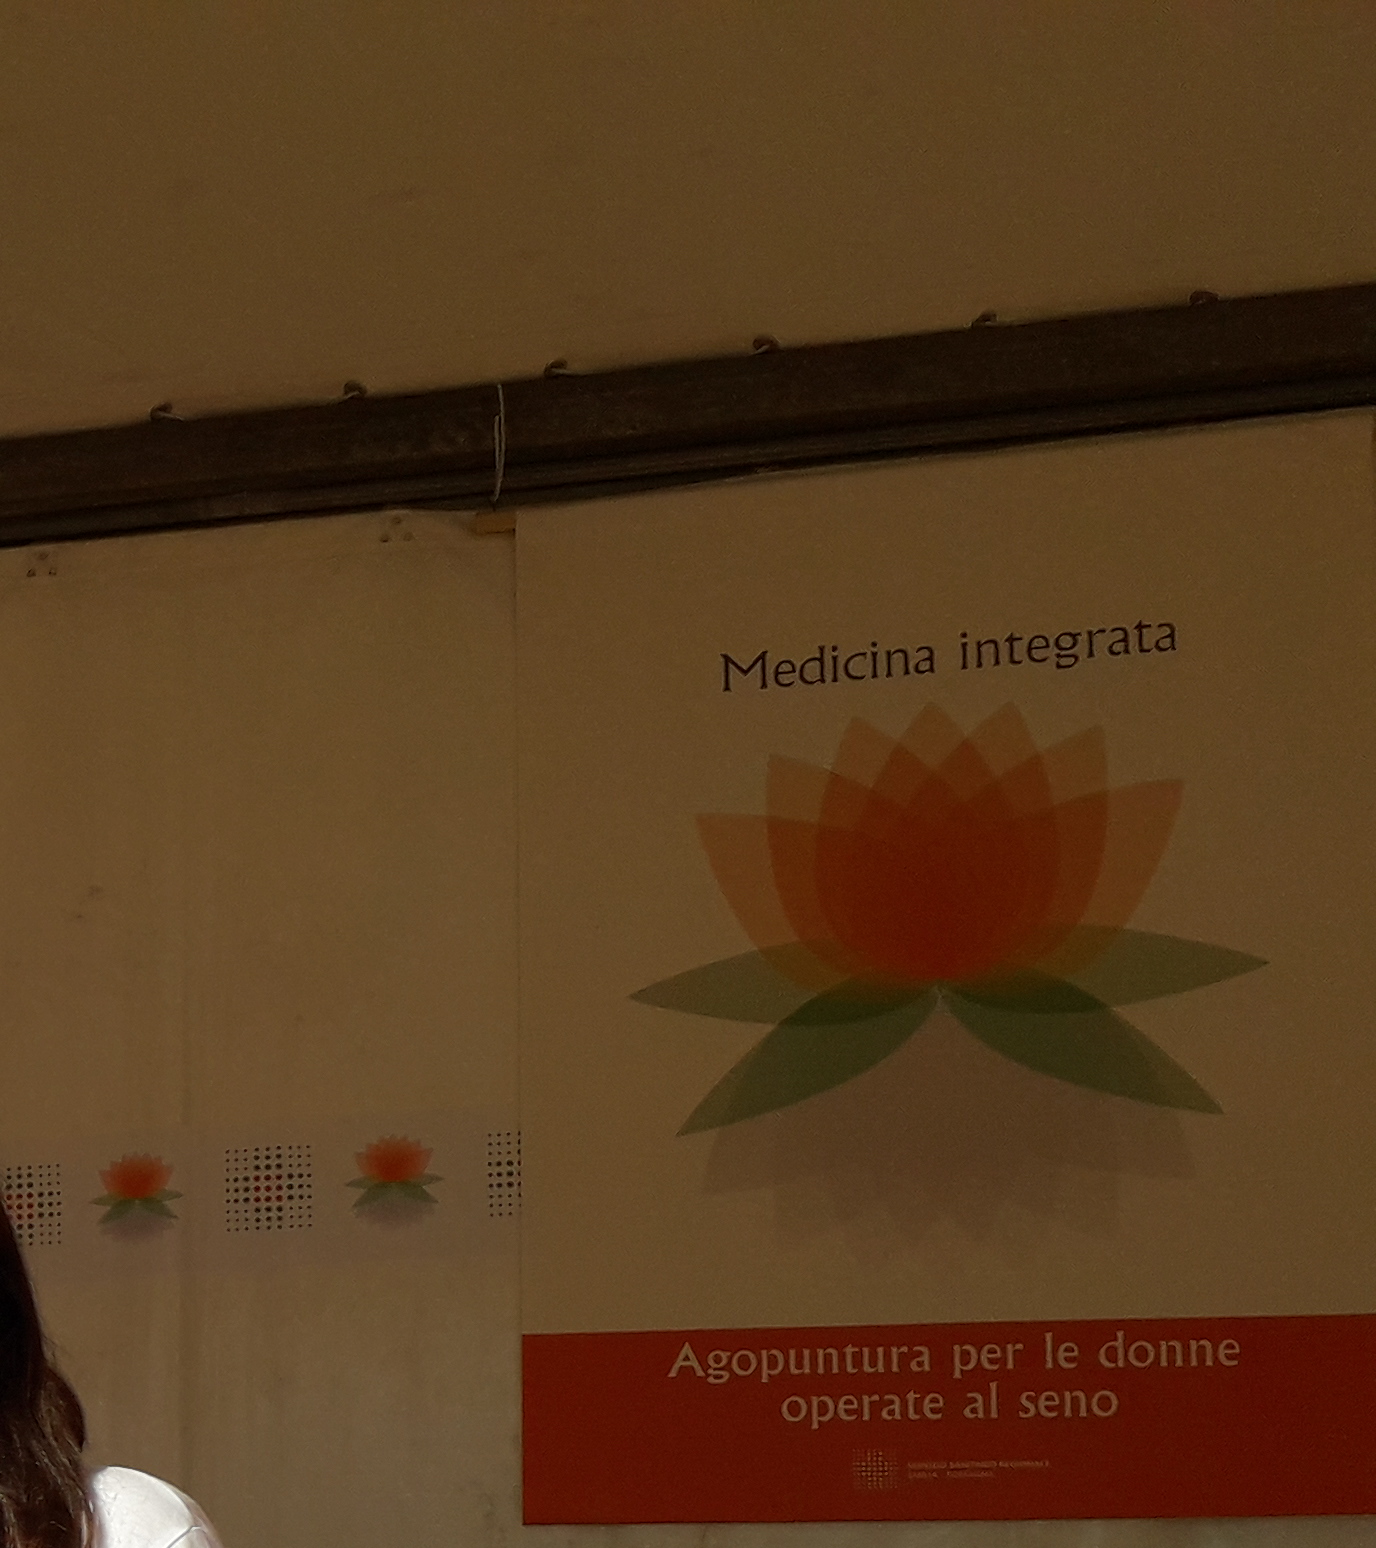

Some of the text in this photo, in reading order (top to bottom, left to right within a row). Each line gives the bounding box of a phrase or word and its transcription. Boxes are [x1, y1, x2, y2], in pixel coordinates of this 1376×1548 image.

[719, 619, 1178, 692] Medicina integrata
[667, 1330, 1241, 1385] Agopuntura per le donne
[780, 1381, 1119, 1429] operate al seno
